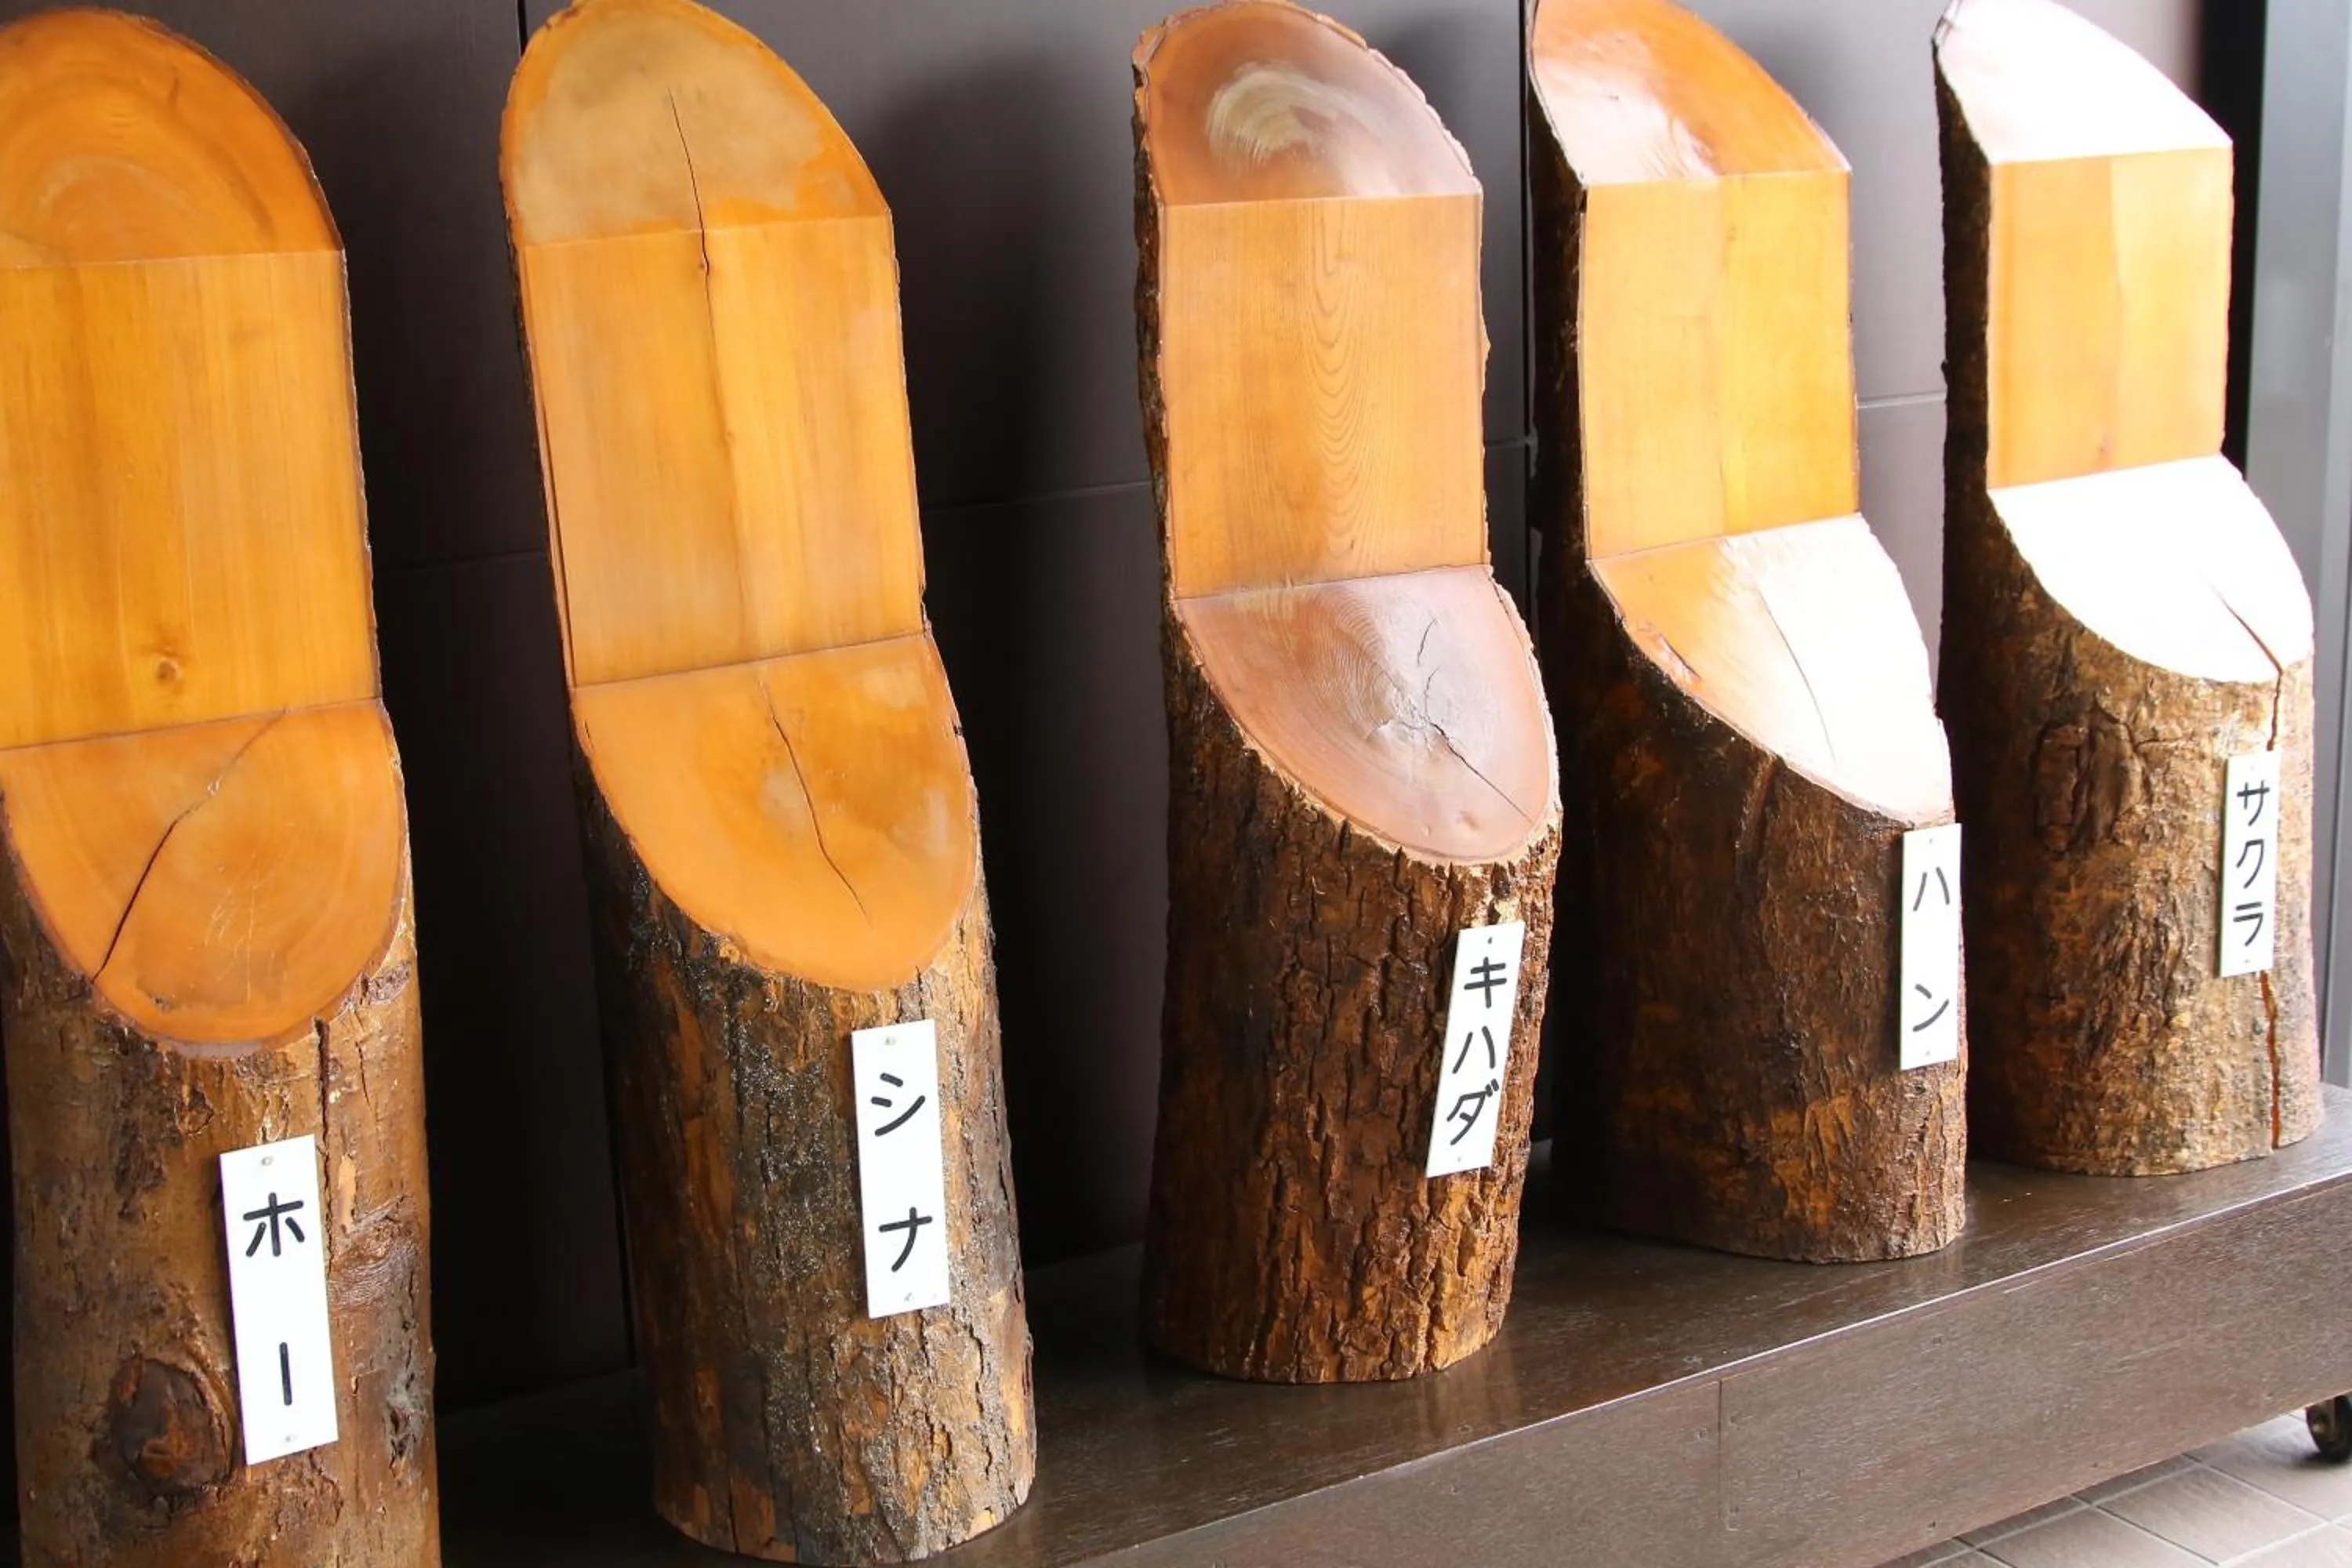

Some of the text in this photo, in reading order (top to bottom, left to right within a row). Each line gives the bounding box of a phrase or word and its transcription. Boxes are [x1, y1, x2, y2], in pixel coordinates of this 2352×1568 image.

[1912, 866, 1951, 1033] ハン
[2232, 780, 2270, 947] サクラ
[1446, 956, 1508, 1146] キハダ
[870, 1072, 933, 1272] シナ
[242, 1192, 306, 1406] ホー
